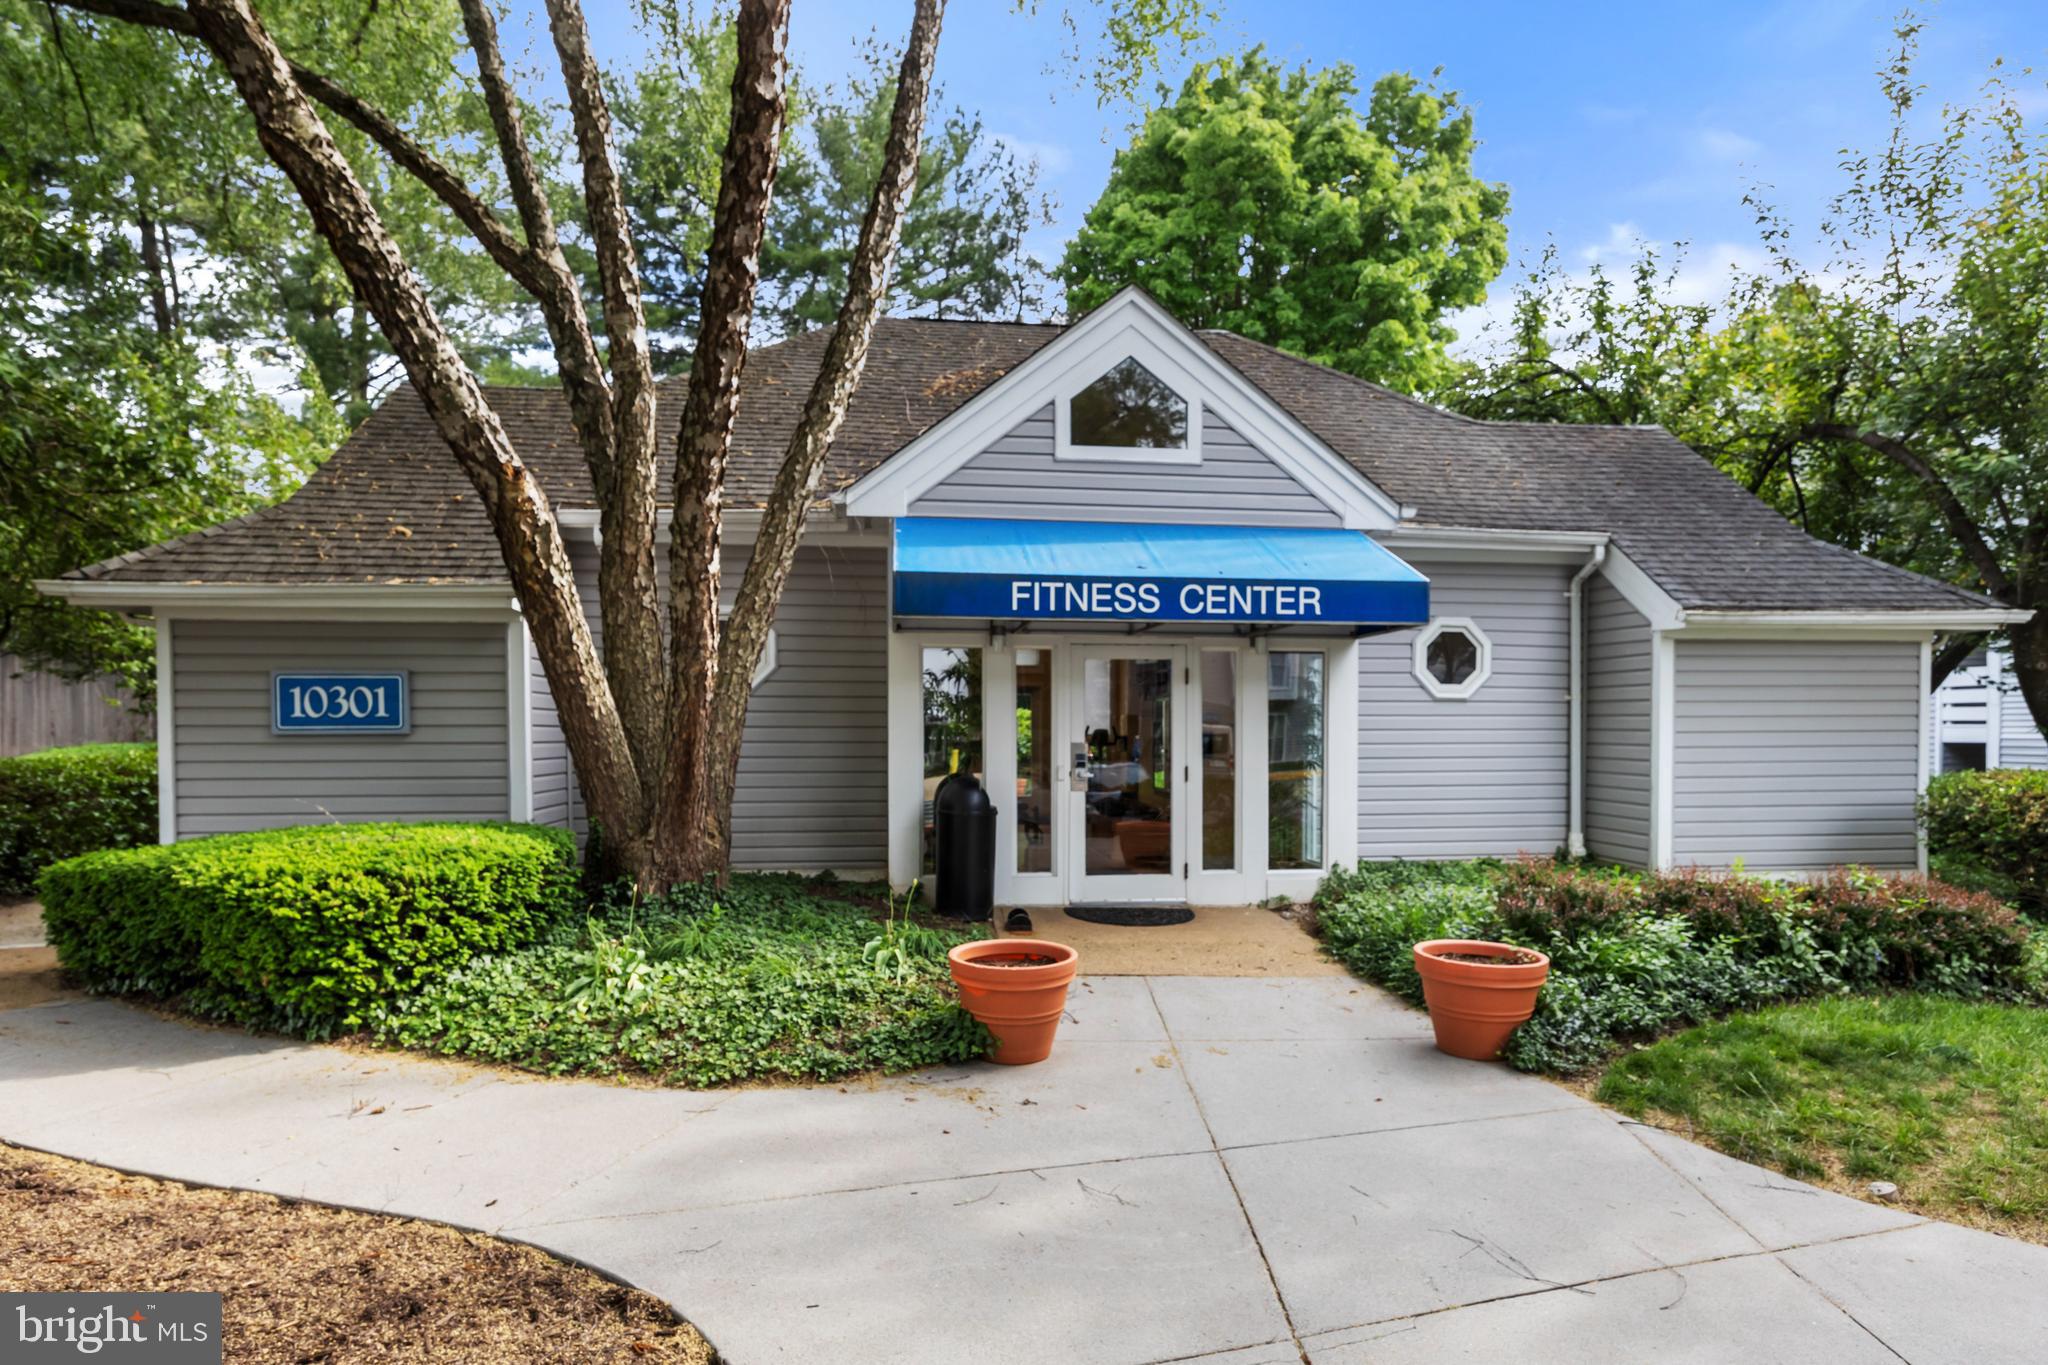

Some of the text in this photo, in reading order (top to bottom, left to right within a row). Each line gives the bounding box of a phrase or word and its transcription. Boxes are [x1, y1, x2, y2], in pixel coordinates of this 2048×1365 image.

[1012, 580, 1323, 615] FITNESS CENTER
[289, 685, 390, 719] 10301
